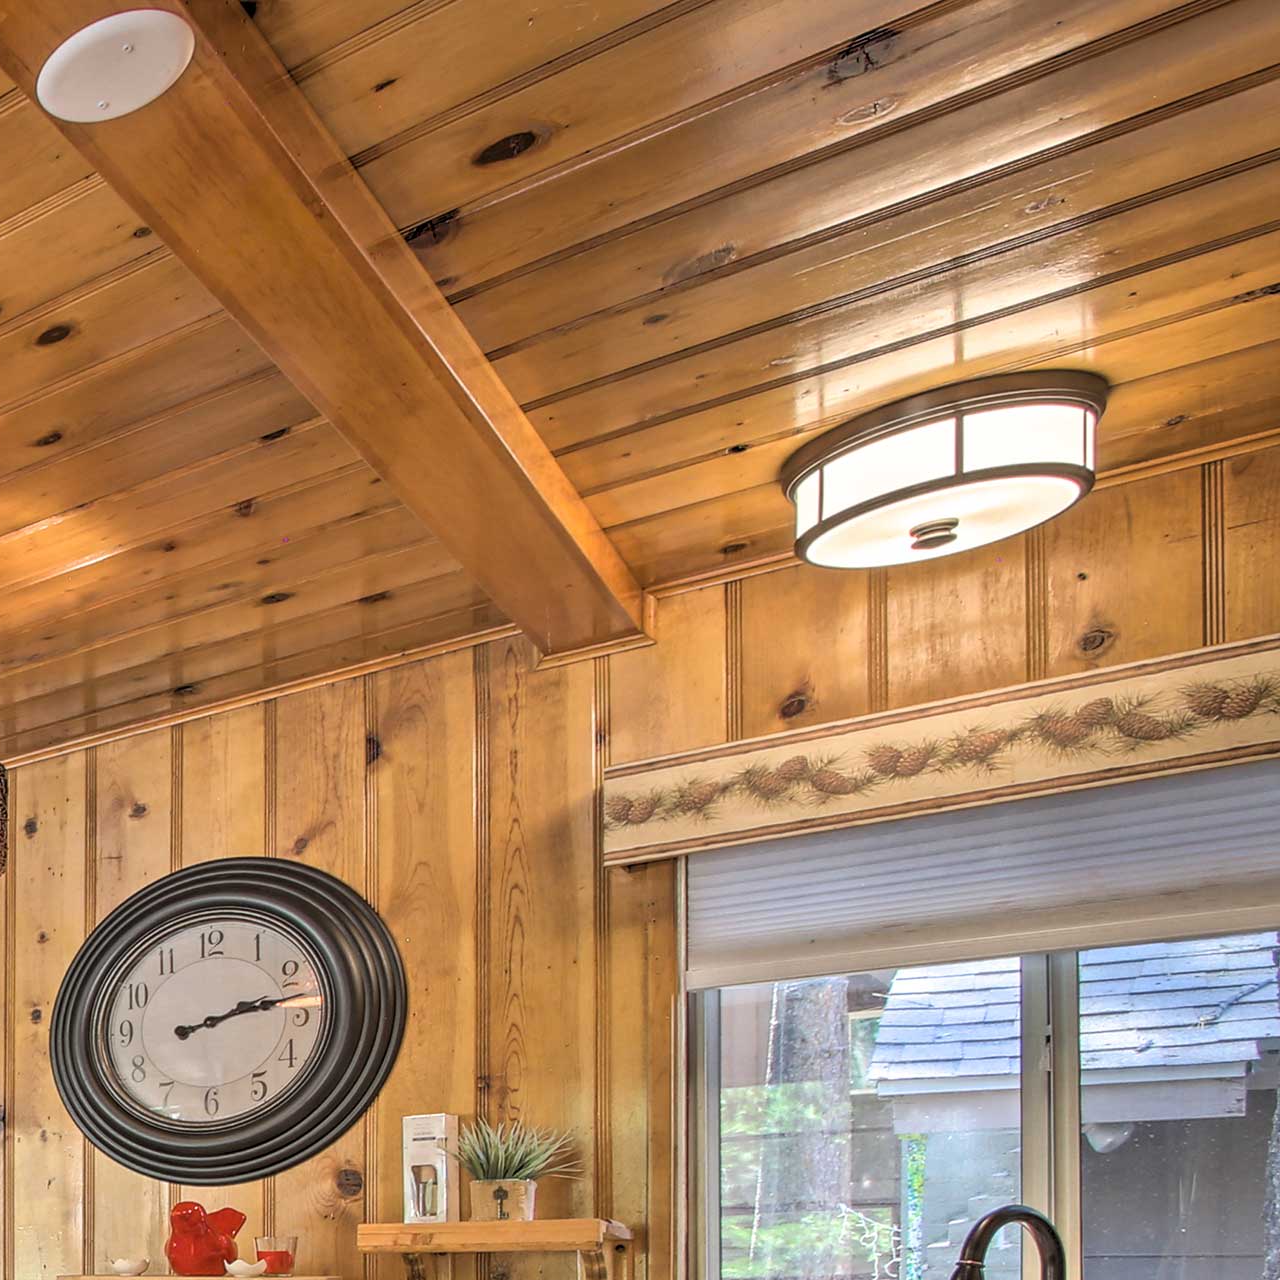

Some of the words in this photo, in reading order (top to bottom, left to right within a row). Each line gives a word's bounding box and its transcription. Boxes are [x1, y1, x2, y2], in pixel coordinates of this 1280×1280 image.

[199, 930, 225, 958] 12
[252, 932, 262, 963] 1
[158, 947, 176, 976] 11
[282, 960, 300, 988] 2
[128, 982, 148, 1010] 10
[119, 1020, 134, 1047] 9
[278, 1038, 297, 1068] 4
[131, 1055, 147, 1083] 8
[158, 1082, 176, 1111] 7
[250, 1071, 268, 1102] 5
[204, 1088, 219, 1116] 6
